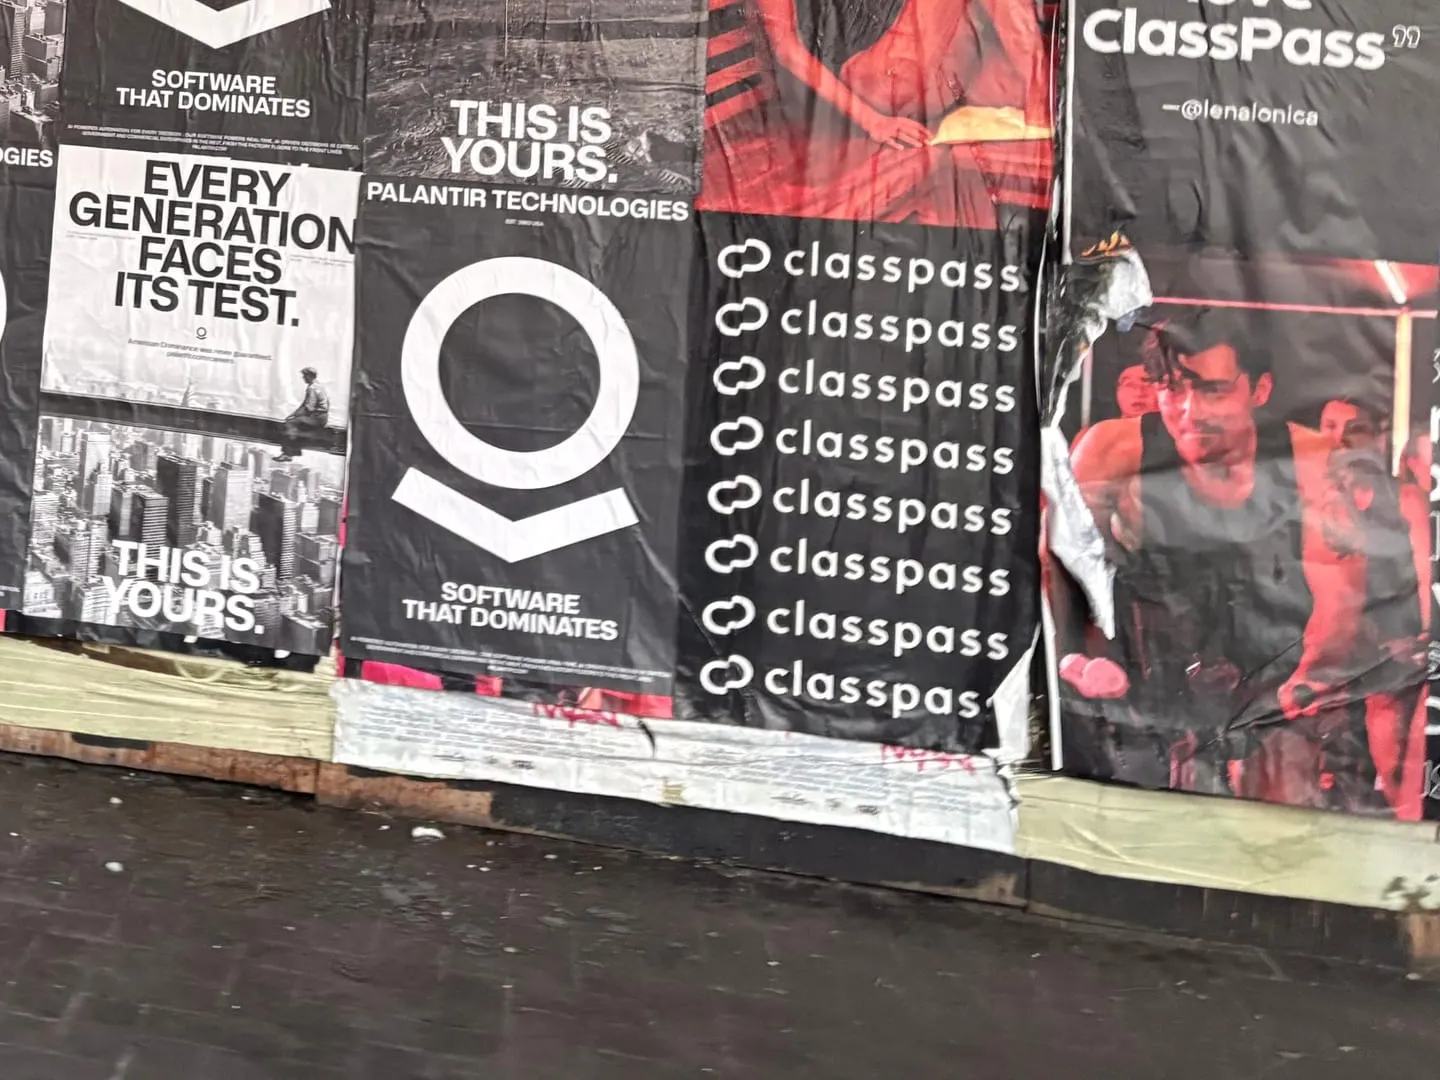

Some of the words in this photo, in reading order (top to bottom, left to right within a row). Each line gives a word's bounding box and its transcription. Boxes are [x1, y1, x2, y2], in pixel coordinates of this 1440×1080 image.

[116, 88, 173, 108] THAT
[178, 92, 310, 117] DOMINATES
[152, 70, 276, 94] SOFTWARE
[450, 100, 557, 140] THIS
[568, 106, 611, 143] IS
[144, 160, 291, 206] EVERY
[441, 137, 617, 185] YOURS.
[69, 192, 357, 254] GENERATION
[368, 182, 486, 207] PALANTIR
[492, 190, 688, 221] TECHNOLOGIES
[139, 236, 281, 284] FACES
[785, 241, 1021, 293] classpass
[115, 272, 178, 312] ITS
[188, 279, 299, 326] TEST.
[781, 301, 1018, 352] classpass
[777, 360, 1016, 413] classpass
[776, 420, 1014, 476] classpass
[773, 479, 1013, 536] classpass
[112, 541, 211, 585] THIS
[221, 554, 260, 591] IS
[770, 539, 1010, 597] classpass
[104, 577, 264, 634] YOURS.
[402, 599, 467, 624] THAT
[471, 607, 618, 640] DOMINATES
[442, 582, 580, 623] SOFTWARE
[766, 602, 1009, 661] classpass
[764, 660, 996, 717] classpas
